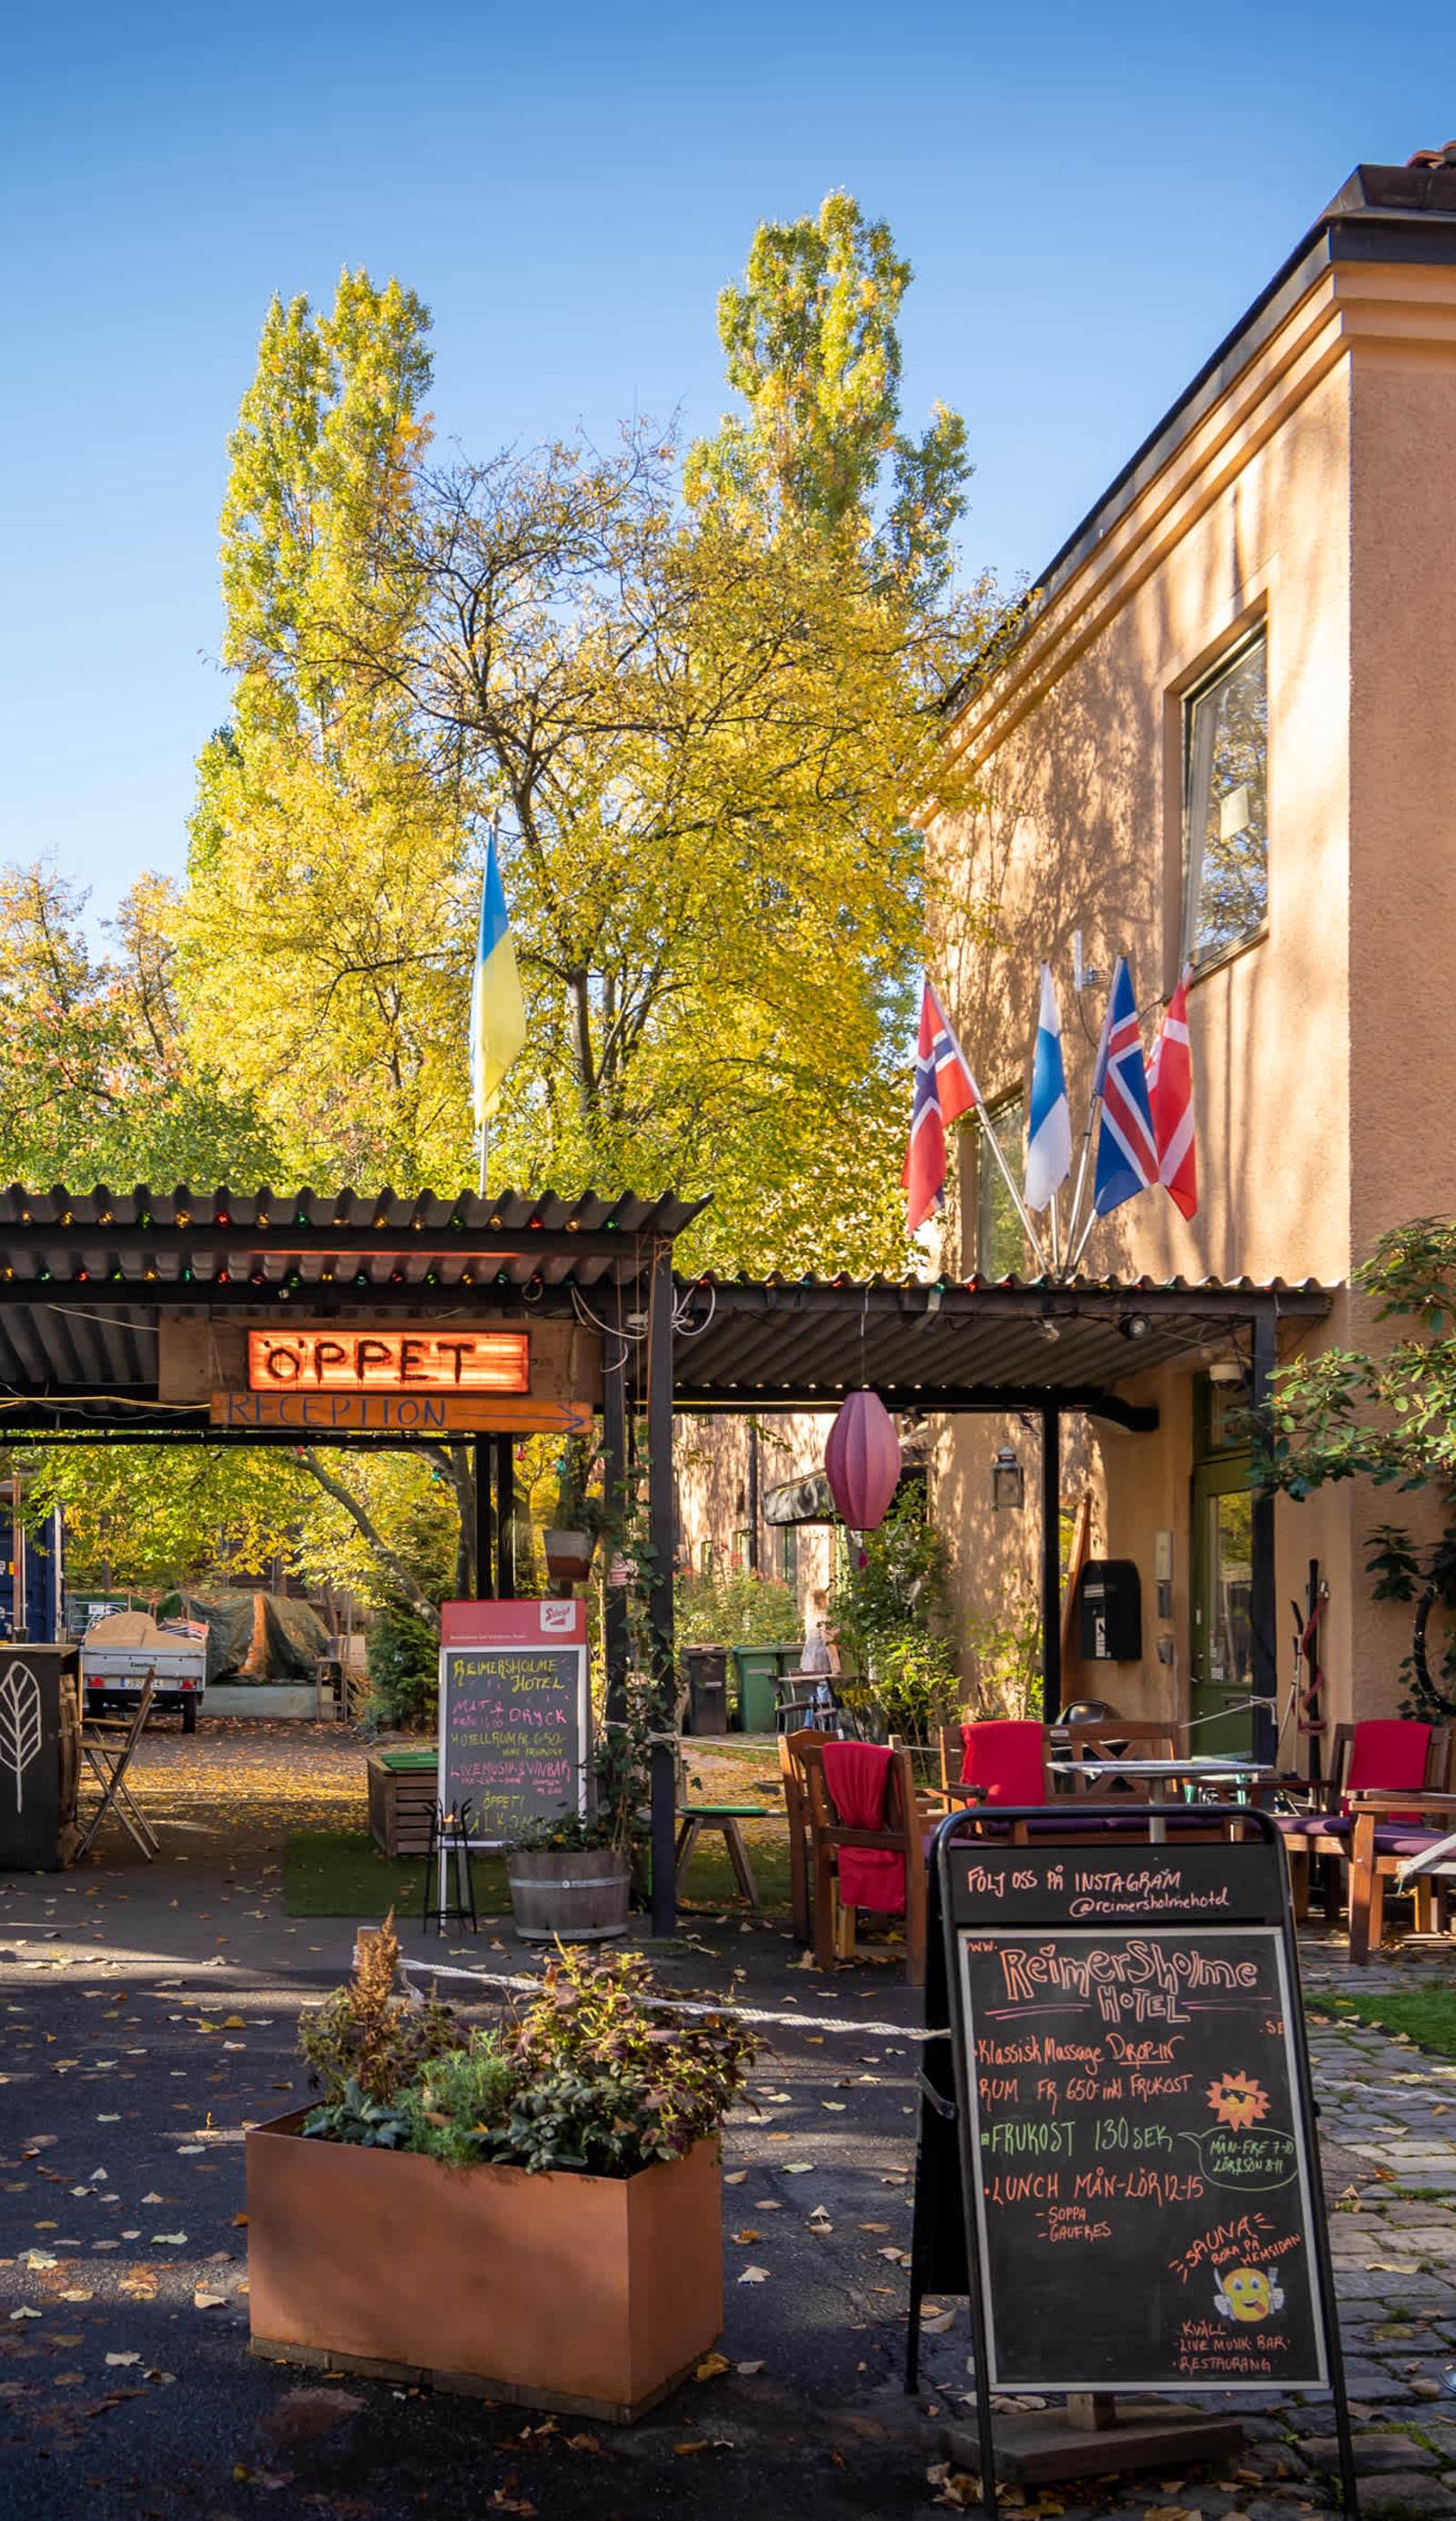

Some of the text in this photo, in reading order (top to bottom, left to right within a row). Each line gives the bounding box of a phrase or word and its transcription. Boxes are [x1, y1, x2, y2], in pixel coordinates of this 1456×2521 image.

[264, 1339, 477, 1384] ÖPPET
[228, 1392, 446, 1428] RECEPTION
[511, 1674, 565, 1693] HOTEL
[509, 1707, 568, 1727] DRYCK
[967, 1864, 1182, 1898] FÖLJ OSS PÅ INSTAGRAM
[1097, 1985, 1190, 2023] HOTEL
[1045, 2038, 1106, 2076] Massage
[979, 2077, 1018, 2111] RUM
[1036, 2079, 1057, 2115] FR
[1129, 2073, 1194, 2104] FRUKOST
[991, 2117, 1174, 2157] FRUKOST 130 SEK
[992, 2166, 1205, 2208] LUNCH MÅN-LÖR 12-15
[1048, 2206, 1087, 2225] SOPPA
[1049, 2221, 1112, 2243] GAUFRES
[1184, 2215, 1253, 2269] SAUNA
[1210, 2233, 1260, 2264] BOKA PÅ
[1240, 2233, 1302, 2265] HEMSIDAN
[1179, 2339, 1209, 2352] LIVE
[1178, 2355, 1272, 2376] RESTAURANG
